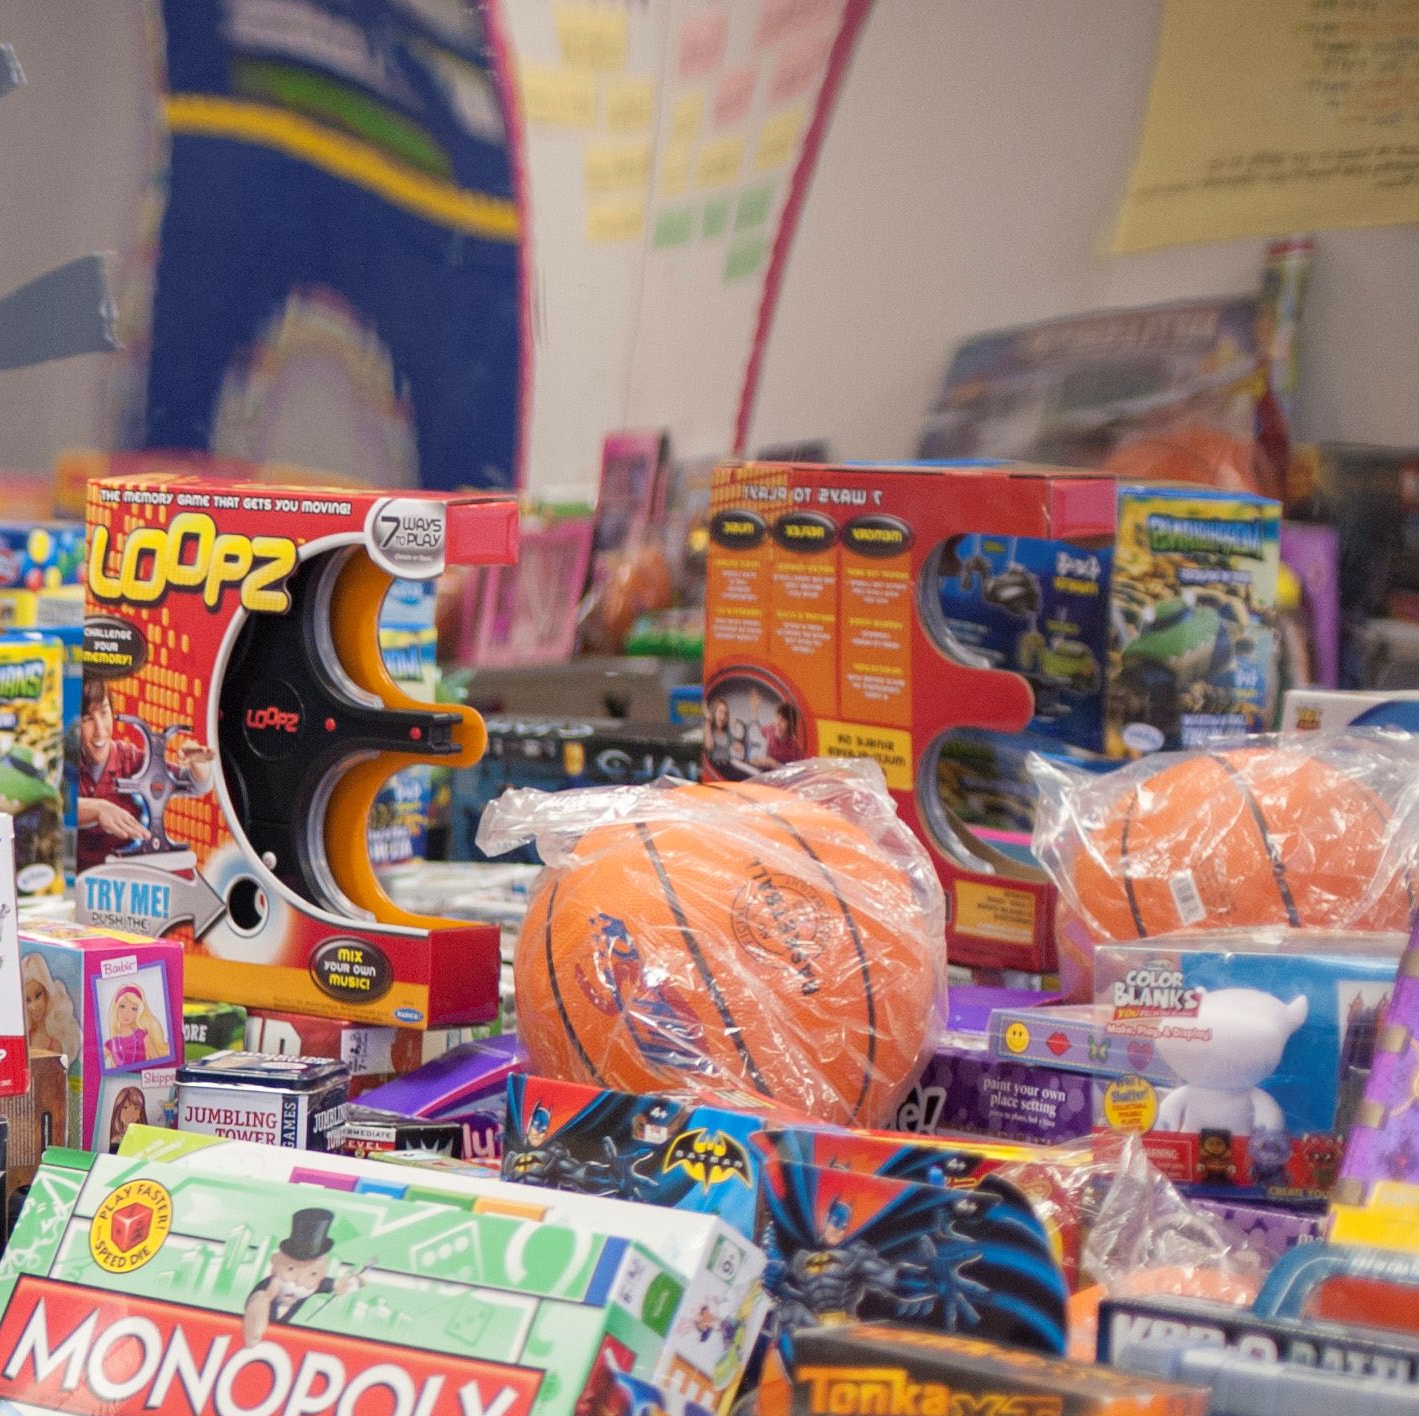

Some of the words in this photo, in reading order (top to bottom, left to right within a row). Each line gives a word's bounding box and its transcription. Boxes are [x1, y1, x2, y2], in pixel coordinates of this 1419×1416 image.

[101, 489, 120, 502] THE
[123, 491, 173, 505] MEMORY
[177, 493, 209, 508] GAME
[214, 496, 239, 509] THAT
[243, 498, 272, 511] GETS
[275, 500, 298, 513] YOU
[302, 501, 351, 515] MOVING!
[381, 516, 400, 548] 7
[401, 517, 441, 533] WAYS
[395, 534, 405, 546] TO
[406, 532, 441, 548] PLAY
[89, 512, 297, 613] LOOPZ
[94, 641, 118, 652] YOUR
[85, 878, 126, 911] TRY
[131, 883, 170, 918] ME!
[105, 959, 136, 976] Barbie
[337, 949, 362, 963] MIX
[324, 962, 350, 973] YOUR
[353, 965, 376, 976] OWN
[1125, 971, 1183, 989] COLOR
[329, 975, 370, 990] MUSIC!
[1113, 984, 1201, 1009] BLANKS
[983, 1078, 1012, 1094] paint
[1014, 1084, 1038, 1099] your
[1041, 1088, 1065, 1101] own
[990, 1093, 1018, 1111] place
[1021, 1098, 1056, 1117] setting
[185, 1106, 277, 1132] JUMBLING
[676, 1150, 743, 1168] BATMAN
[100, 1186, 133, 1221] PLAY
[136, 1183, 171, 1231] FASTER!
[95, 1241, 127, 1268] SPEED
[129, 1246, 152, 1267] DIE
